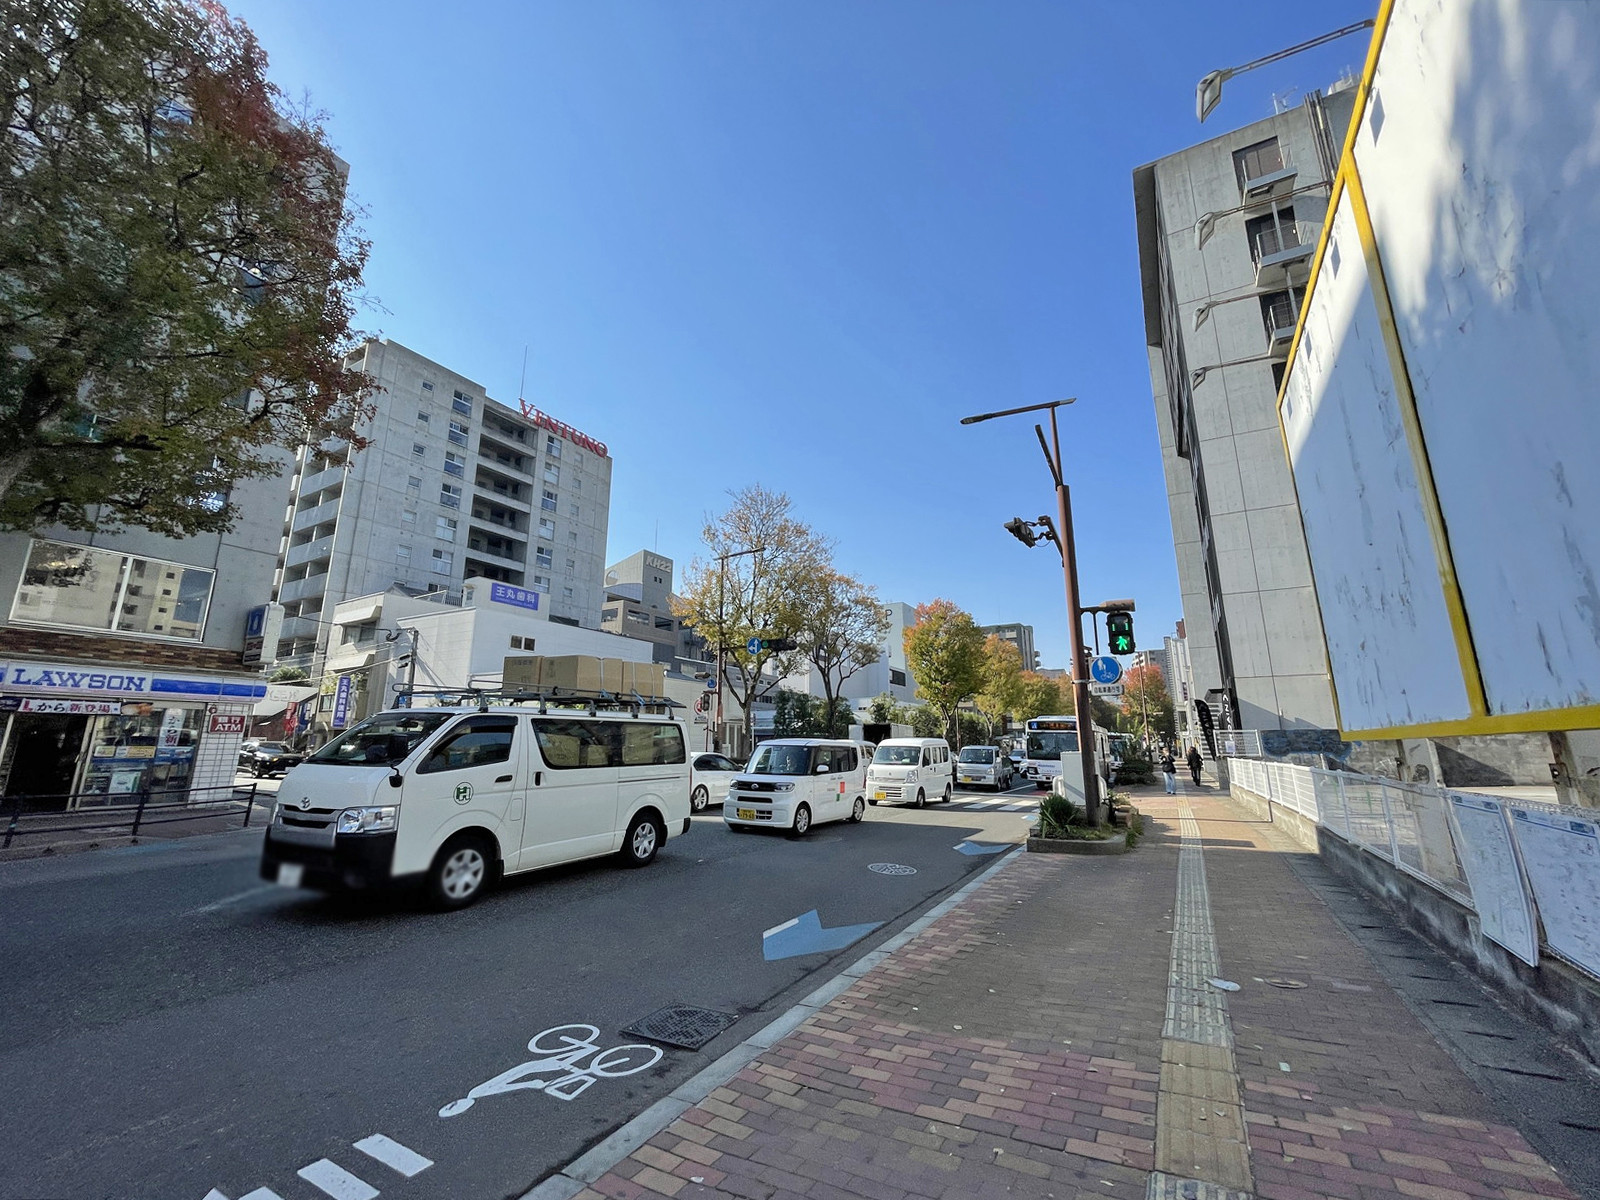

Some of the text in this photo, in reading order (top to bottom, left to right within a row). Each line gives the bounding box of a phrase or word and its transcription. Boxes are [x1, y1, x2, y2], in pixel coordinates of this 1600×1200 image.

[519, 398, 608, 458] VENTUNO
[646, 555, 672, 573] KH22
[495, 586, 536, 604] 王丸歯科
[12, 667, 147, 693] LAWSON
[214, 723, 242, 732] ATM
